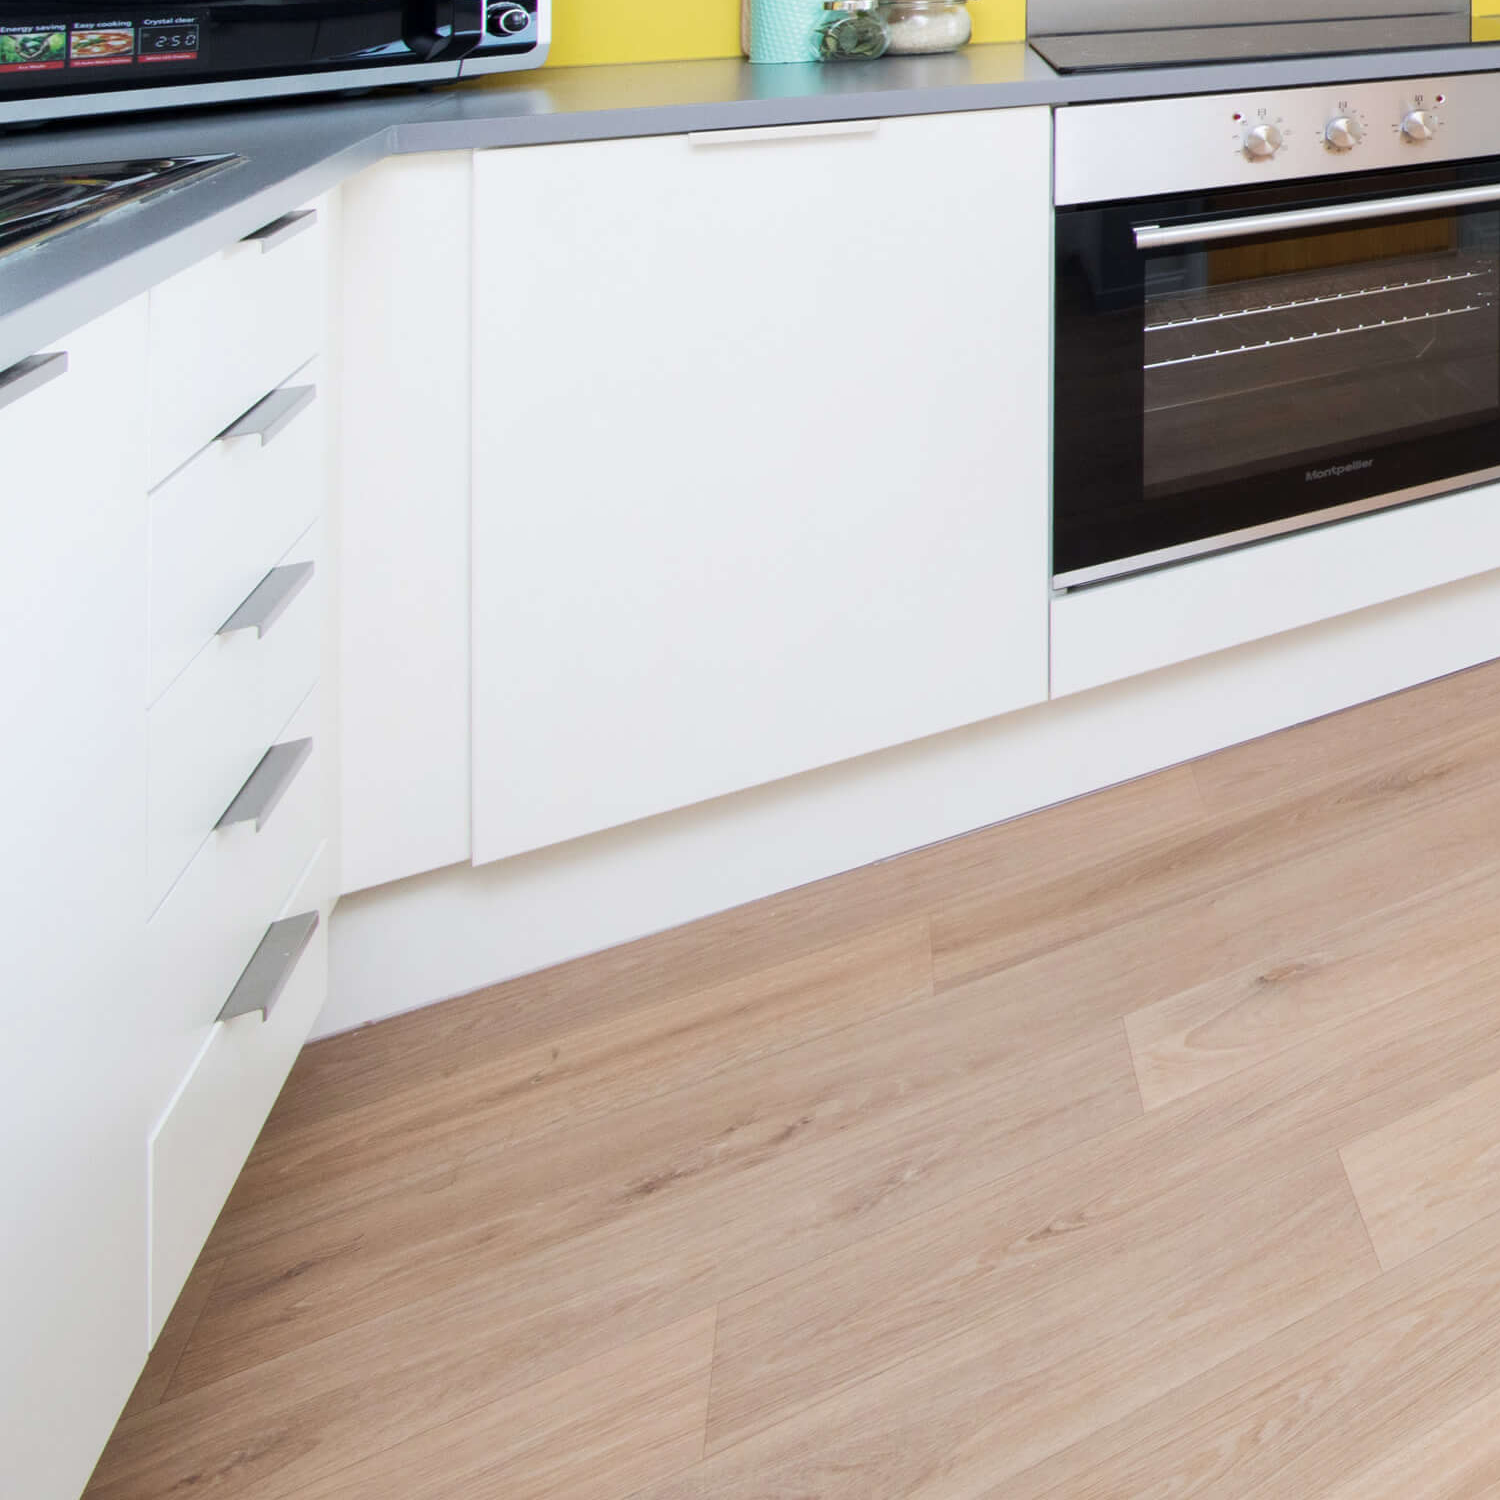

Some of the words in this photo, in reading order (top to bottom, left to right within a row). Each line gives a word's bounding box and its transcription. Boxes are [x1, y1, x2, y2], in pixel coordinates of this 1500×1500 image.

[74, 21, 96, 29] Easy
[97, 19, 133, 28] cooking
[143, 17, 174, 26] Crystal
[175, 16, 195, 24] clear
[0, 26, 33, 34] Energy
[35, 23, 67, 32] saving
[1304, 459, 1375, 482] Montpellier
